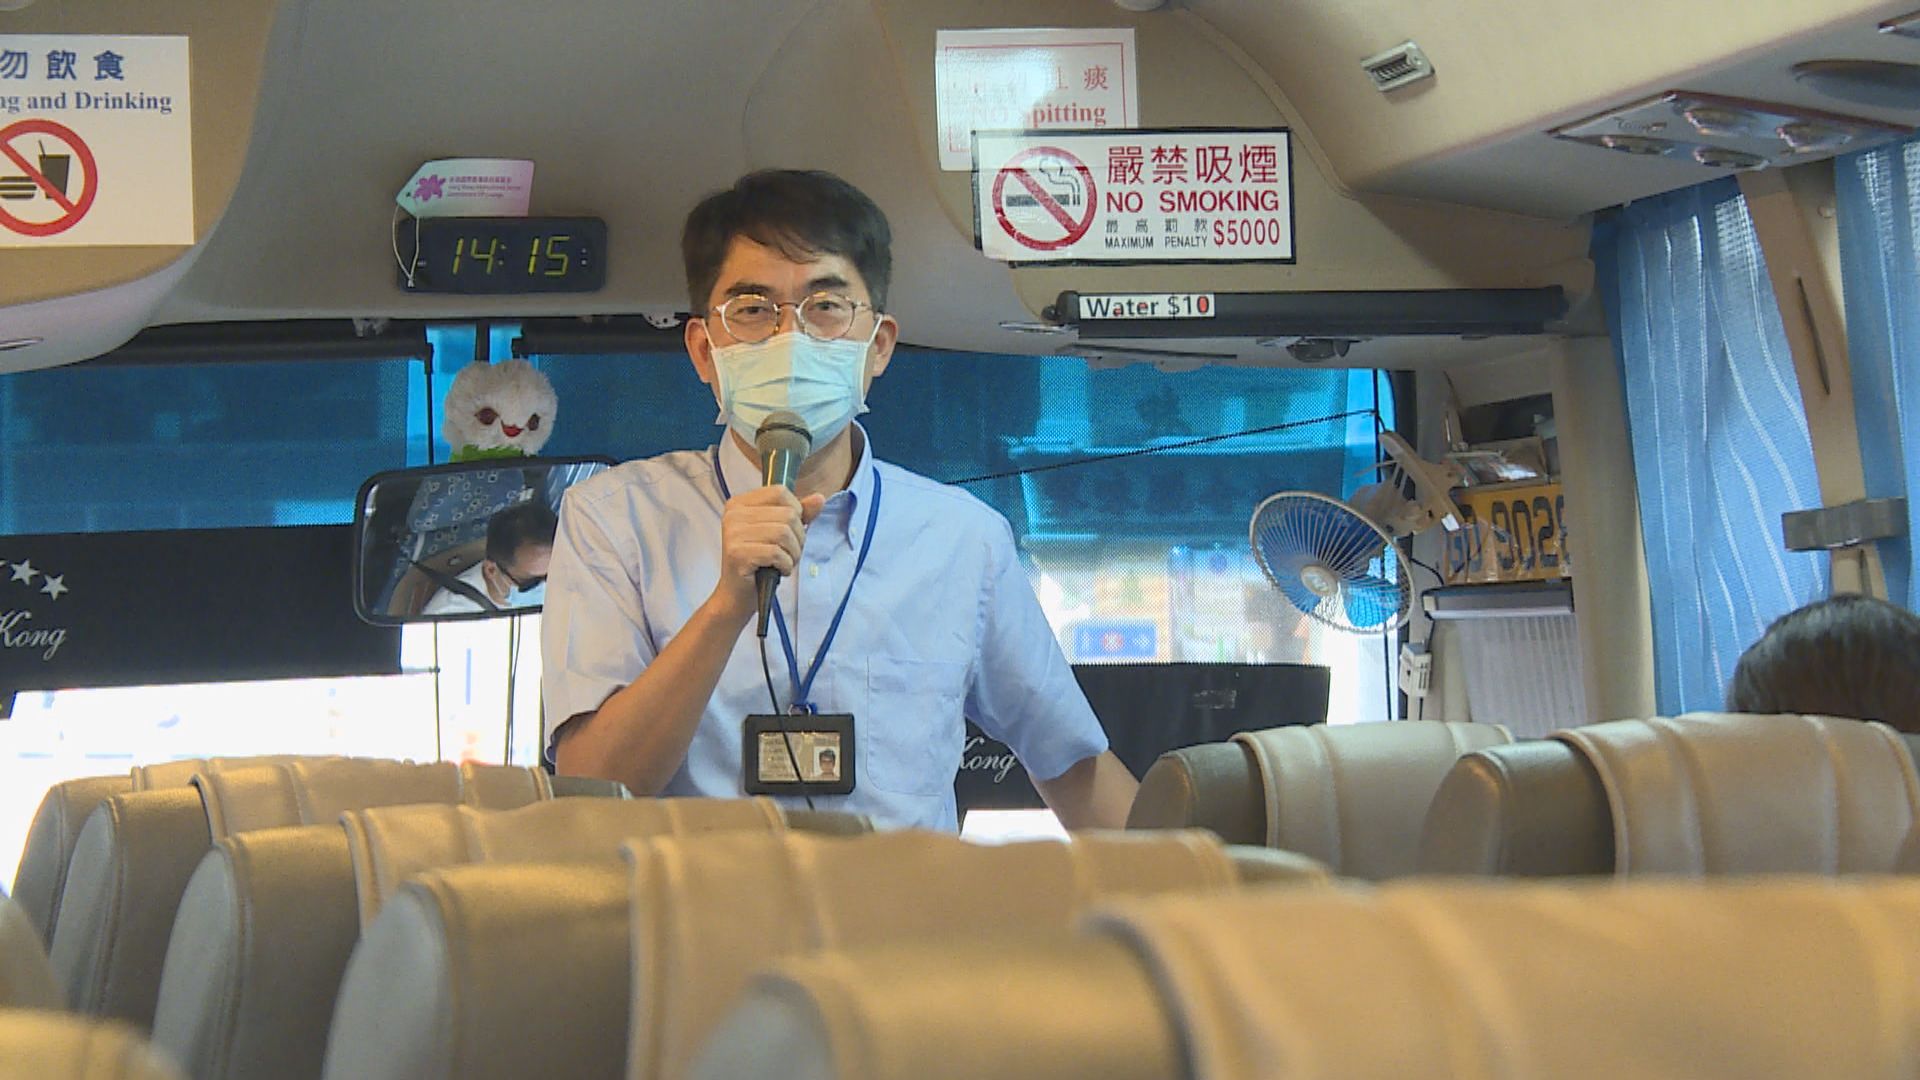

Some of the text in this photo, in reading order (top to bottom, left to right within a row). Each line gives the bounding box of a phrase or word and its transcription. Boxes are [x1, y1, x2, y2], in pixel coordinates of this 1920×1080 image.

[0, 50, 125, 81] 勿飲食
[27, 92, 67, 109] and
[75, 91, 173, 115] Drinking
[1026, 102, 1106, 128] pitting
[1107, 145, 1278, 185] 嚴禁吸煙
[1106, 190, 1279, 213] NO SMOKING
[1105, 236, 1208, 249] MAXIMUM PENALTY
[1213, 218, 1280, 247] $5000
[1086, 295, 1210, 319] Water $10
